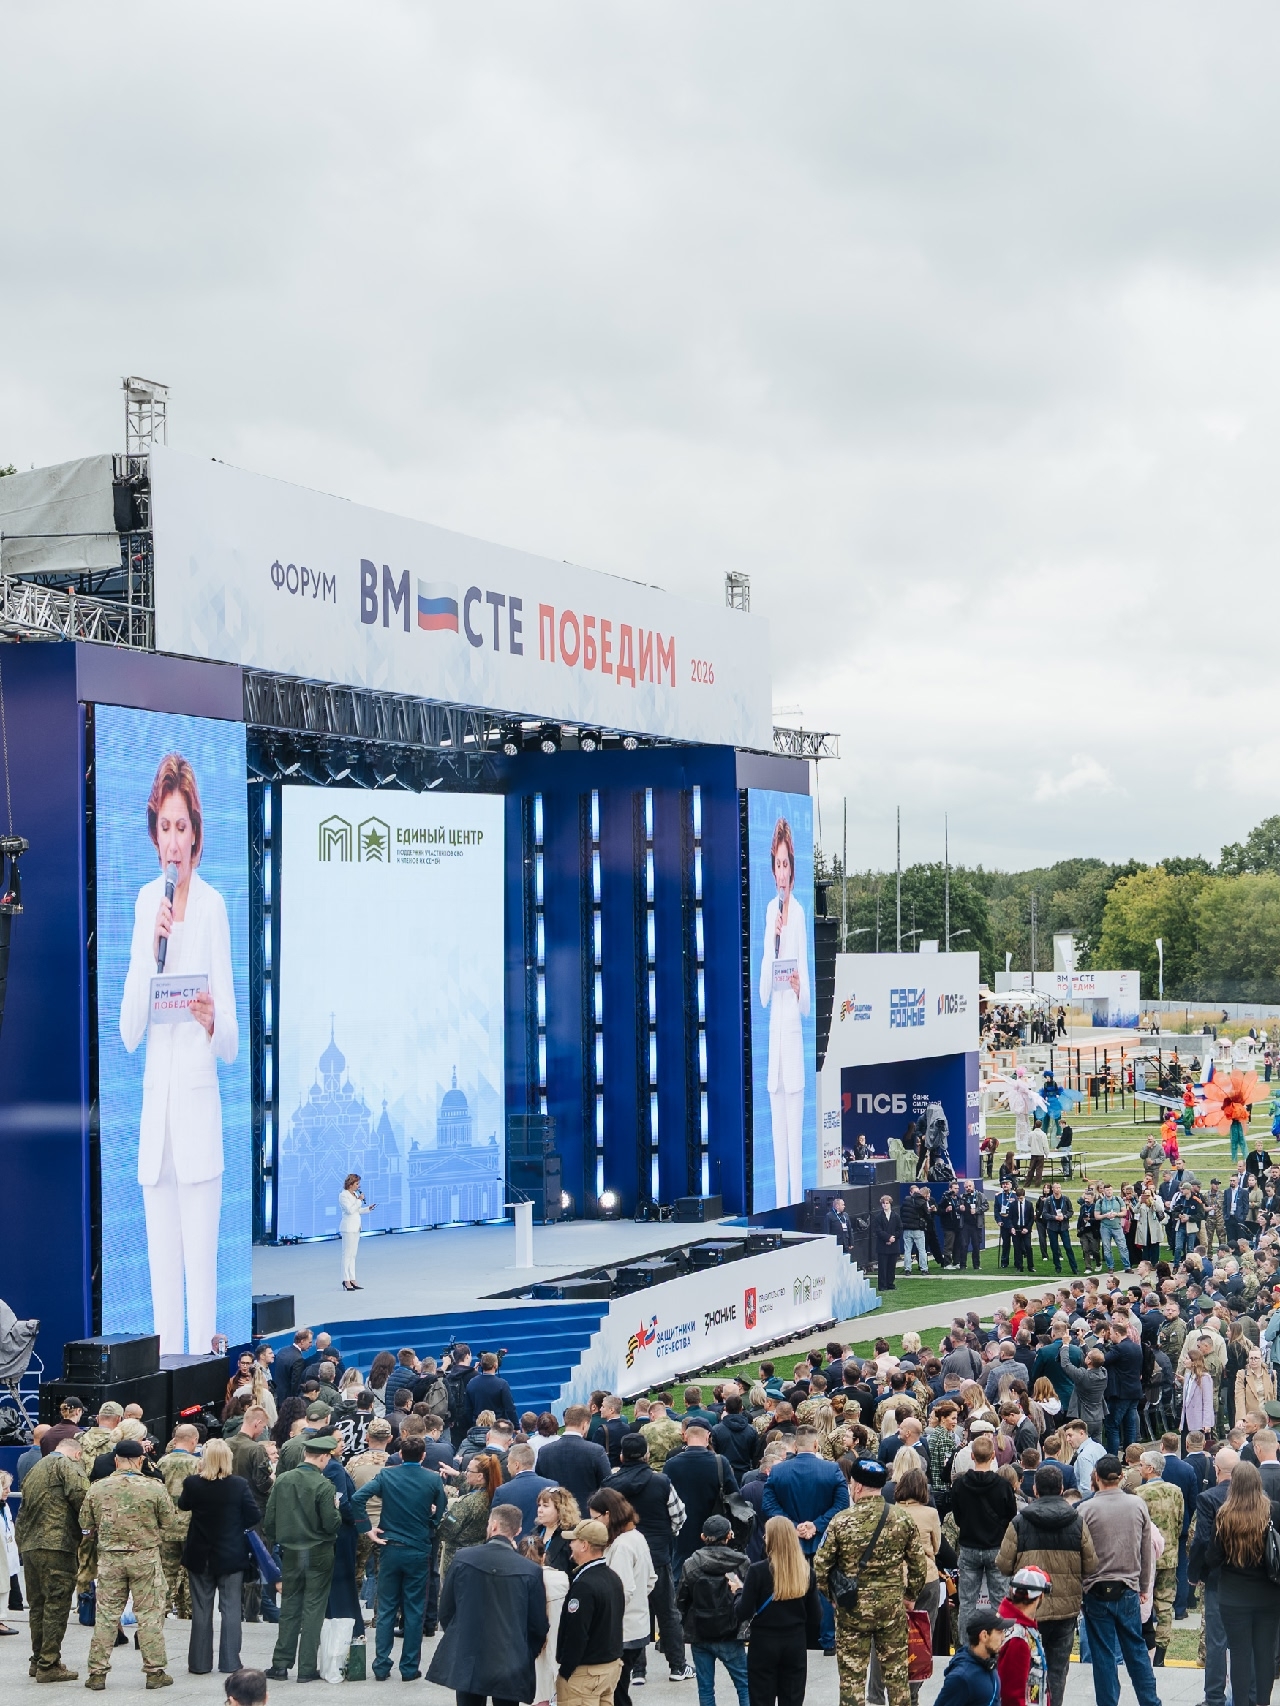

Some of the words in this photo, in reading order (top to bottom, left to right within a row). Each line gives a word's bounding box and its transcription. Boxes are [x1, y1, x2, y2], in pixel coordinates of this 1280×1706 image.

[270, 559, 337, 604] ФОРУМ
[538, 603, 677, 689] ПОБЕДИМ
[690, 659, 715, 685] 2026
[396, 825, 446, 846] ЕДИНЫЙ
[448, 829, 484, 847] ЦЕНТР
[1057, 983, 1095, 991] ПОЕДИМ
[154, 999, 200, 1011] ПОБЕДИ
[944, 993, 959, 1015] ПСБ
[856, 1093, 908, 1114] ПСБ
[912, 1093, 930, 1101] банк
[656, 1320, 696, 1344] ЗАЩИТНИКИ
[656, 1336, 692, 1358] ОТЕЧЕСТВА
